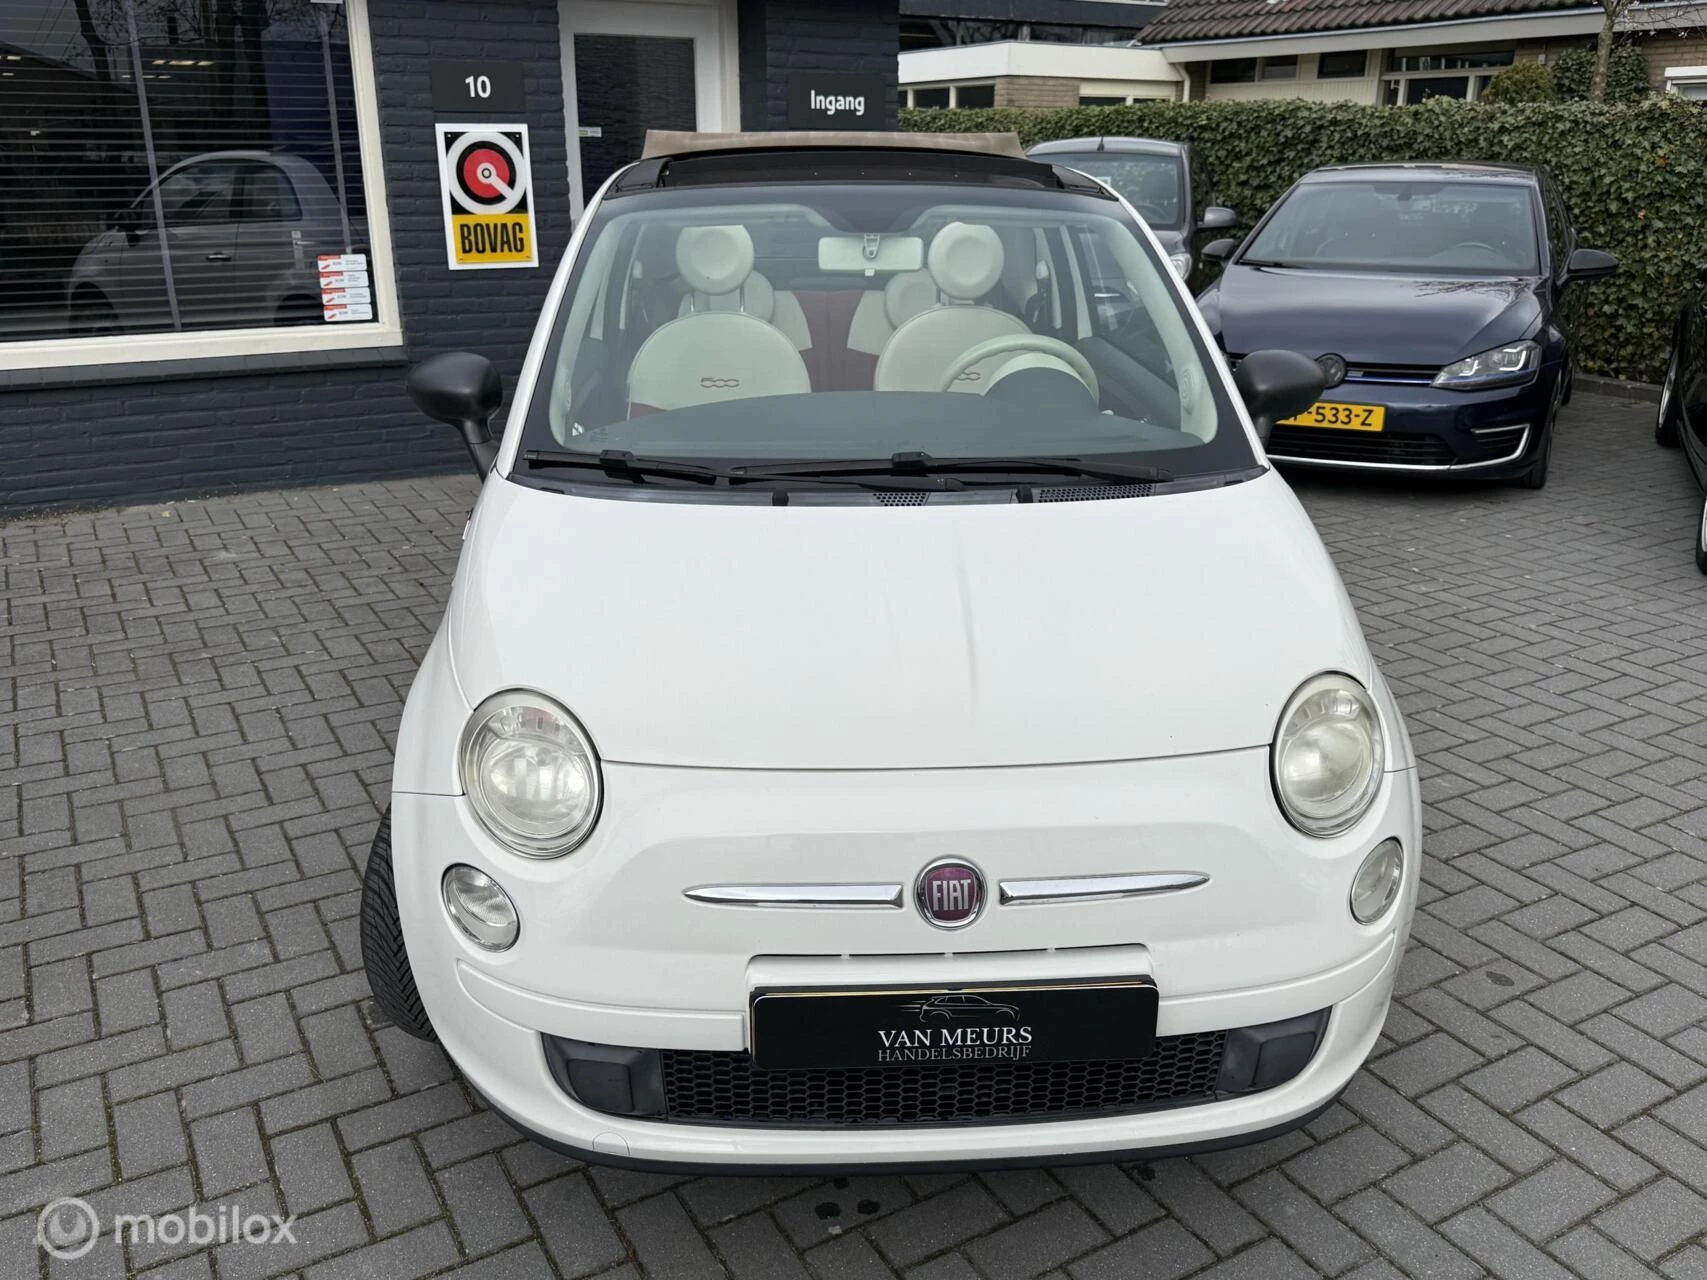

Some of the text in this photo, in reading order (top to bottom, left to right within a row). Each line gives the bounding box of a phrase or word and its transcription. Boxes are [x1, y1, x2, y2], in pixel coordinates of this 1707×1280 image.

[464, 75, 492, 98] 10
[810, 89, 865, 116] Ingang
[459, 221, 525, 254] BOVAG
[1293, 405, 1374, 427] -533-Z
[932, 879, 972, 911] FIAT
[877, 1026, 1033, 1048] VAN MEURS
[877, 1045, 1032, 1061] HANDELSBEDRIJF
